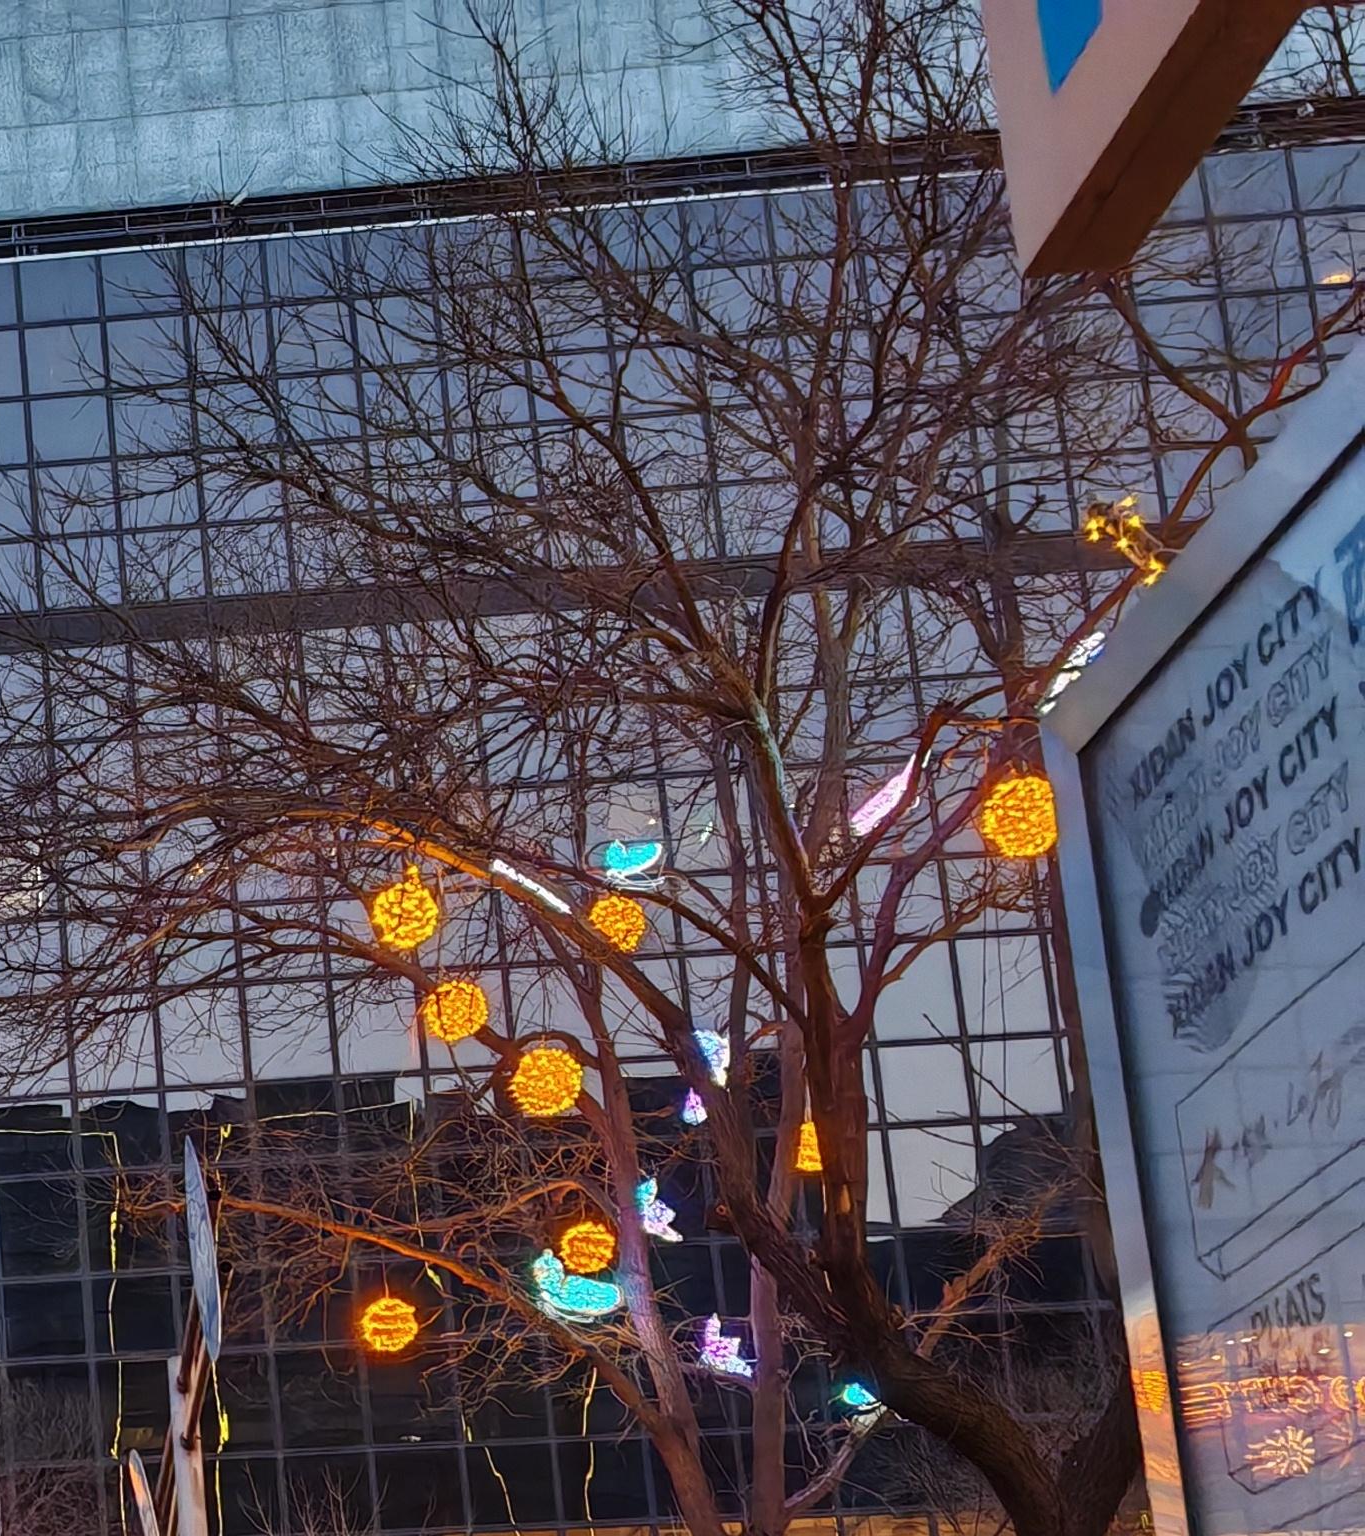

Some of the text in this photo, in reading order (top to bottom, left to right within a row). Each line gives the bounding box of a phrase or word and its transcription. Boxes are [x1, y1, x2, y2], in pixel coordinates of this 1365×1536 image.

[1202, 643, 1251, 728] JOY
[1257, 585, 1319, 666] CITY
[1222, 767, 1270, 845] JOY
[1279, 695, 1338, 788] CITY
[1242, 887, 1290, 968] JOY
[1298, 826, 1362, 916] CITY
